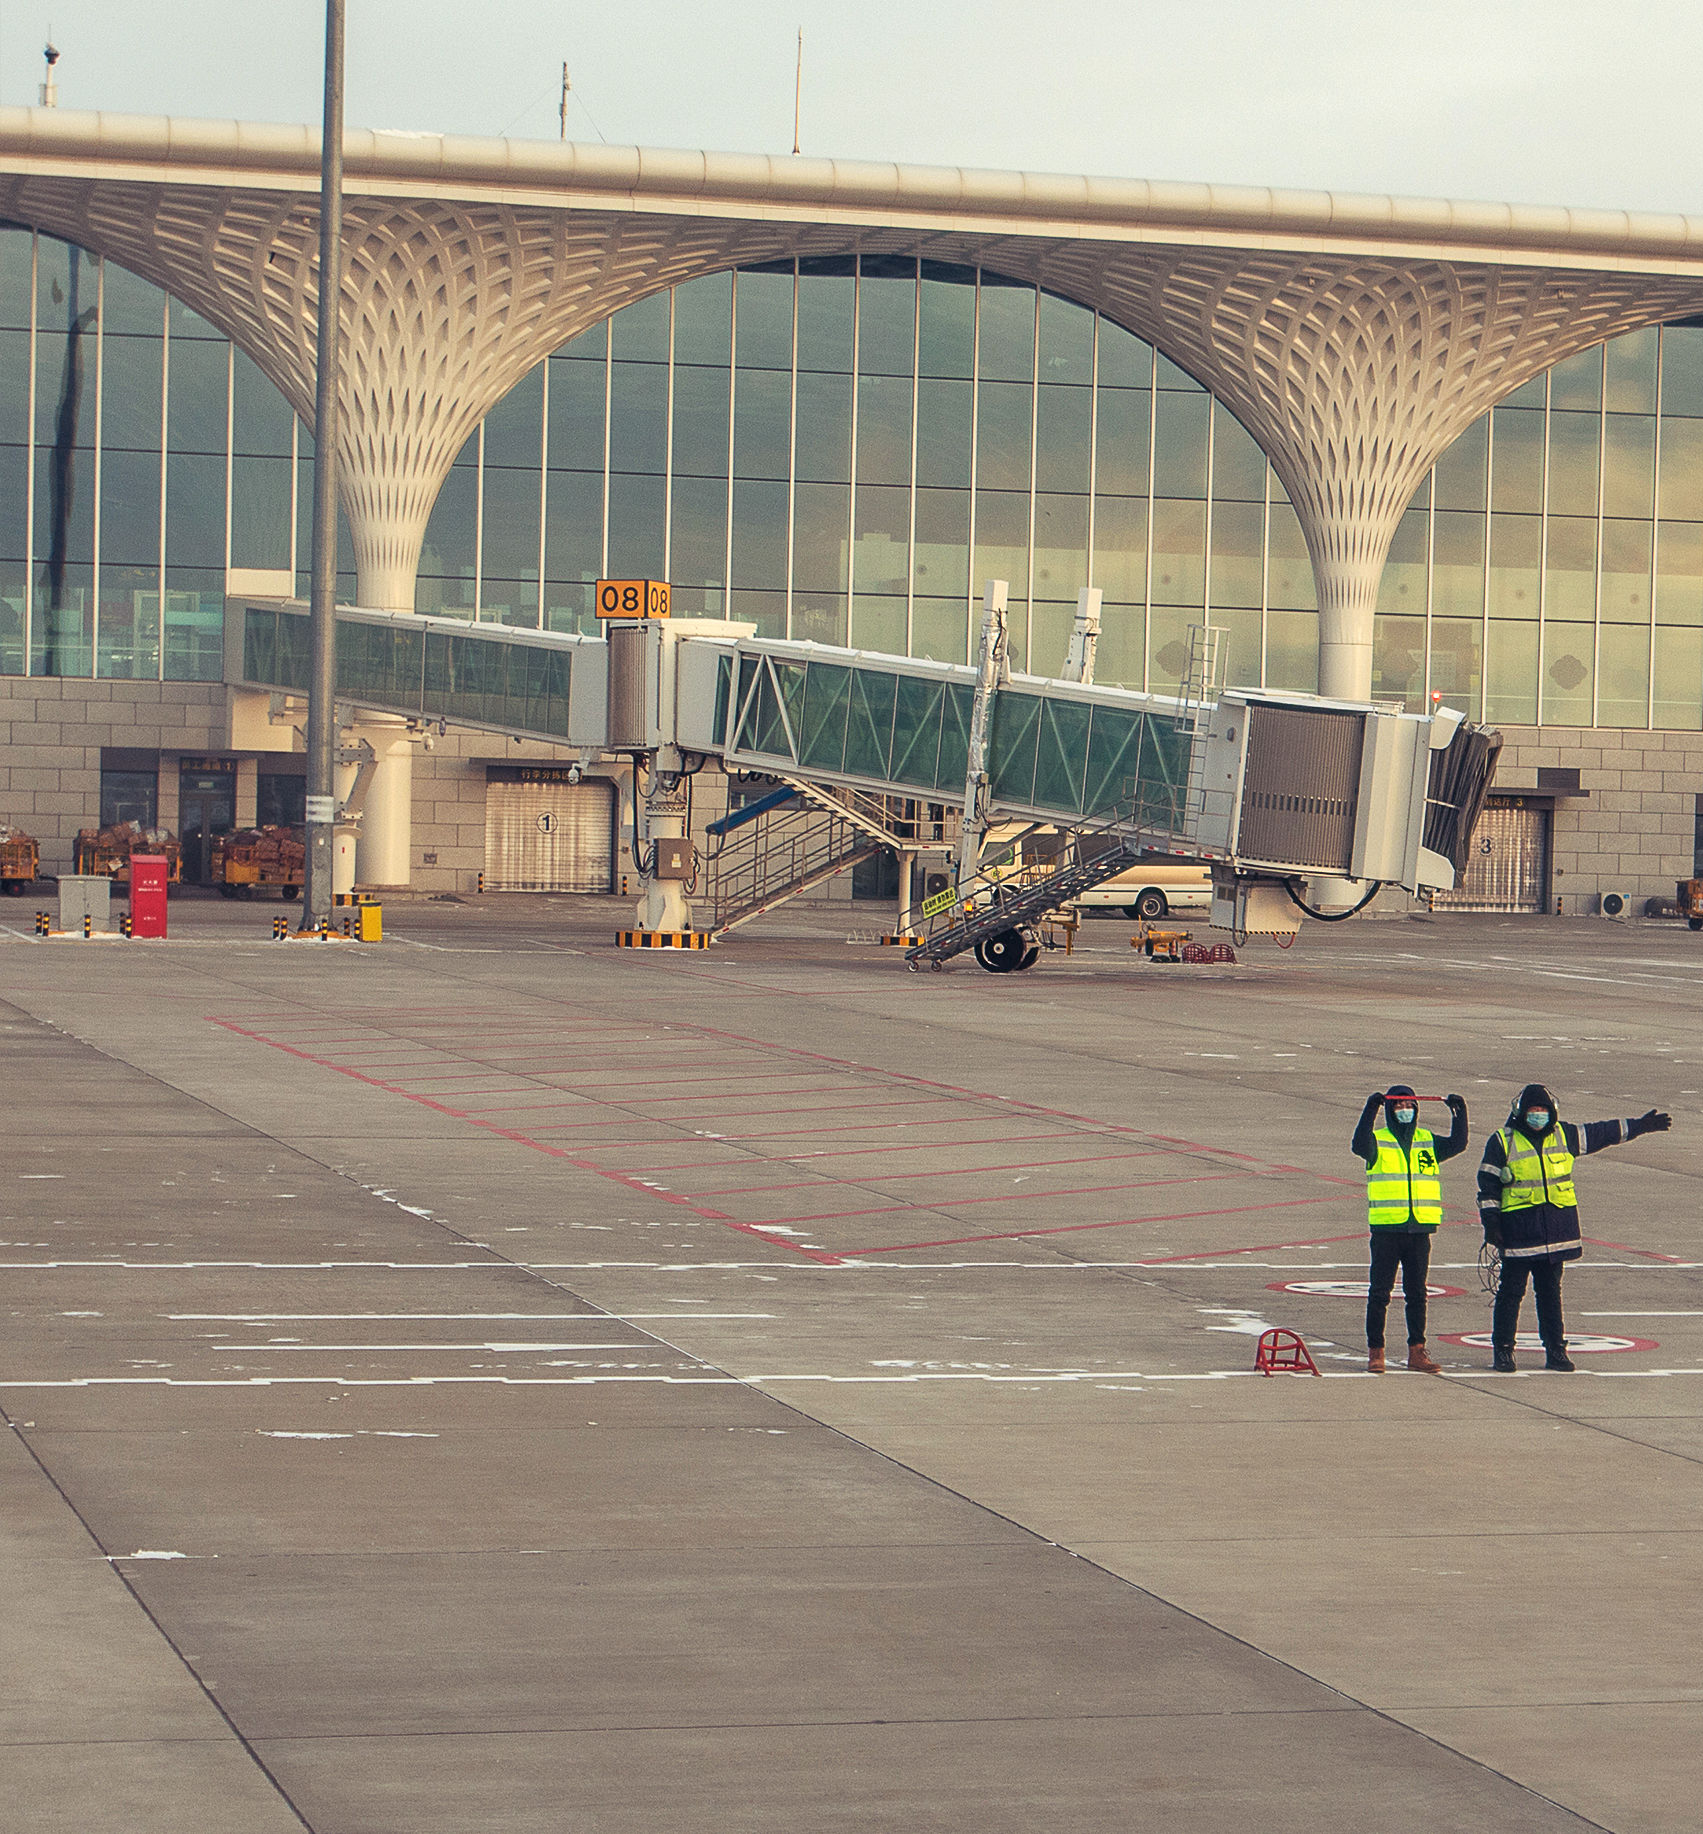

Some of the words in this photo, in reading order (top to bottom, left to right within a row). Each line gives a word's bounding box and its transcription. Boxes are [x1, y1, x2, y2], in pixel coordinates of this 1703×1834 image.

[602, 586, 639, 612] 08
[651, 587, 667, 614] 08
[542, 815, 550, 831] 1
[1481, 838, 1492, 854] 3
